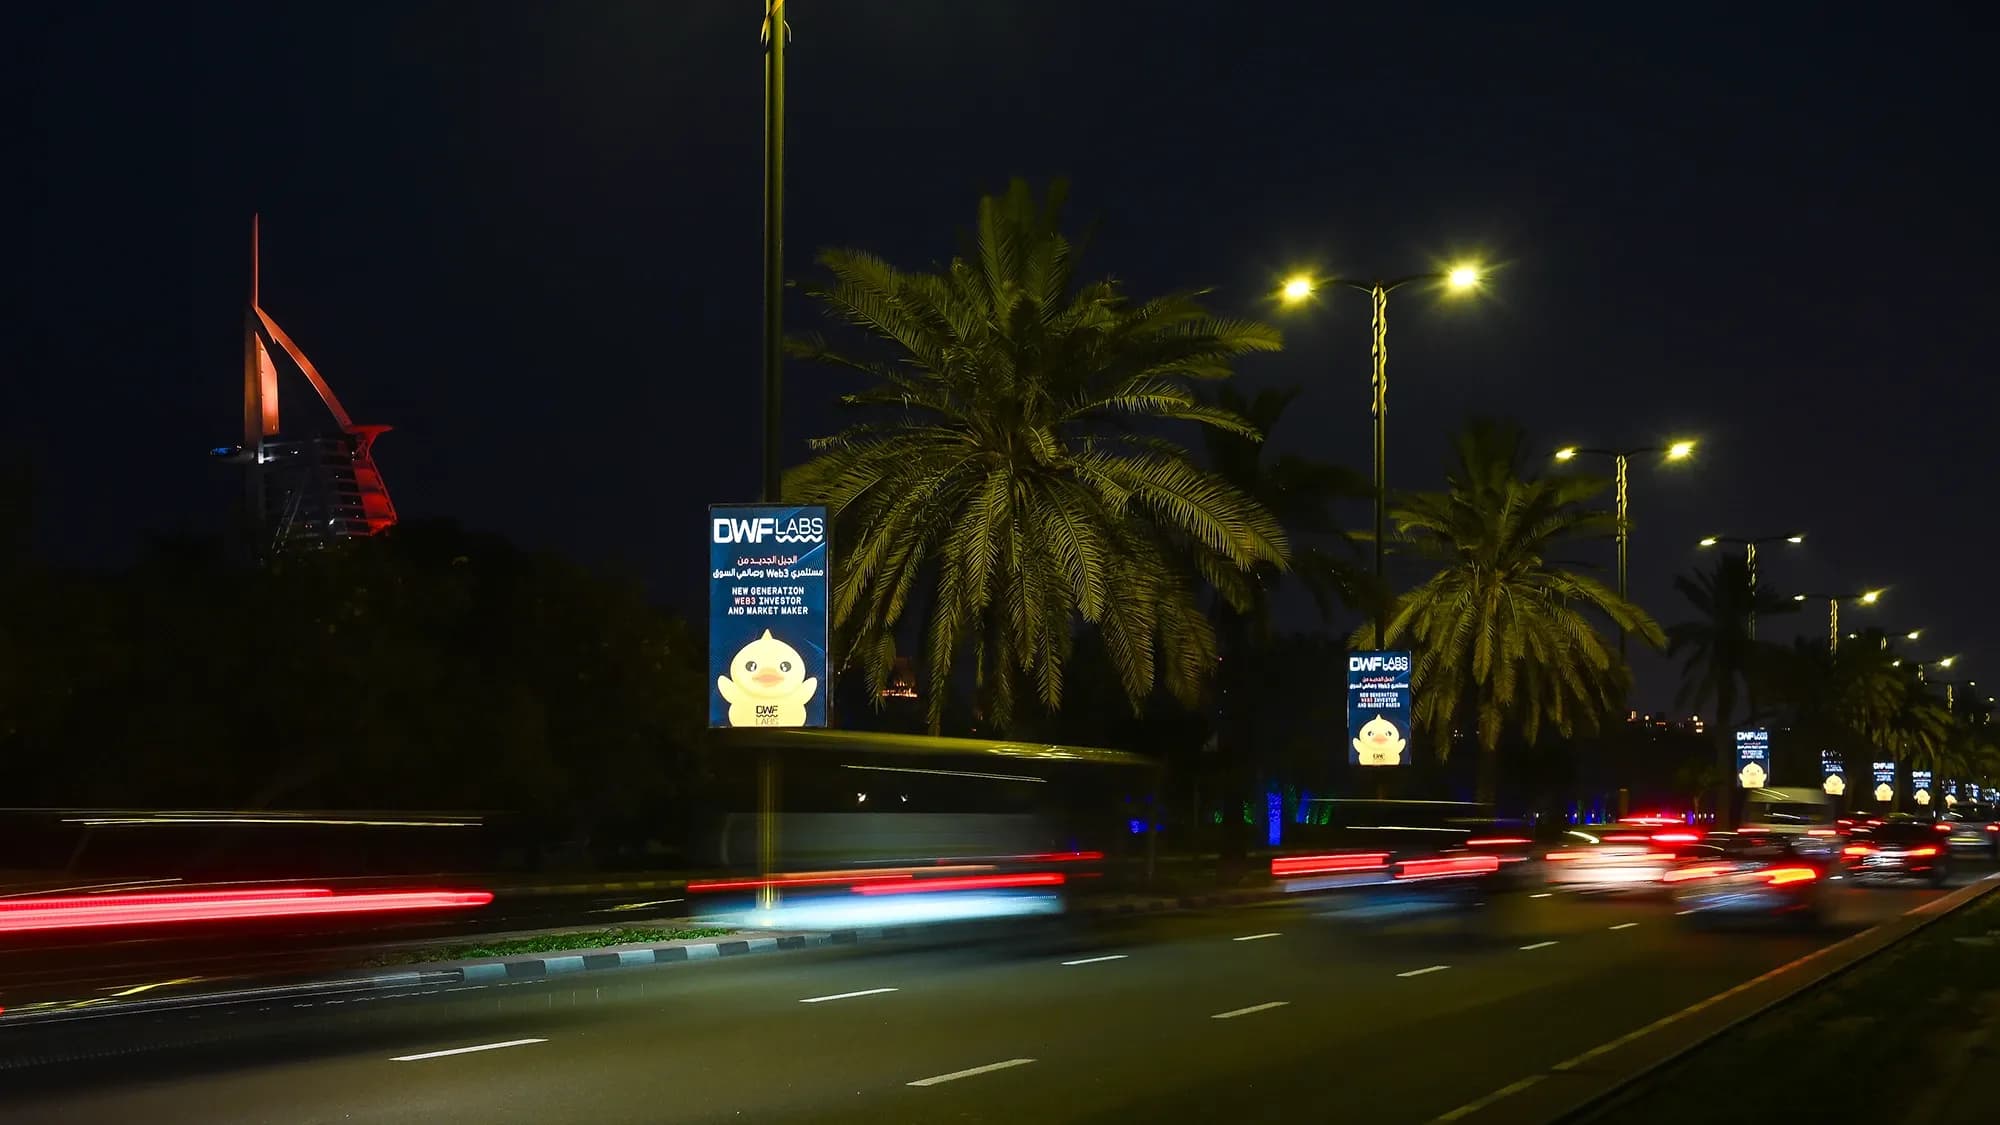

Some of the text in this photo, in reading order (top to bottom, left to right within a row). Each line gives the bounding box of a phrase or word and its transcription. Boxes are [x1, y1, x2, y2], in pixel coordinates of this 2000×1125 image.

[713, 518, 824, 543] DWF LABS
[737, 557, 749, 566] من
[777, 556, 798, 566] الجيل
[712, 568, 736, 579] السوق
[766, 569, 789, 578] Web3
[732, 587, 805, 595] NEW GENERATION
[734, 597, 802, 605] WEB3 INVESTOR
[728, 606, 809, 615] AND MARKET MAKER
[1350, 656, 1408, 671] DWF LABS
[756, 705, 779, 714] DWF
